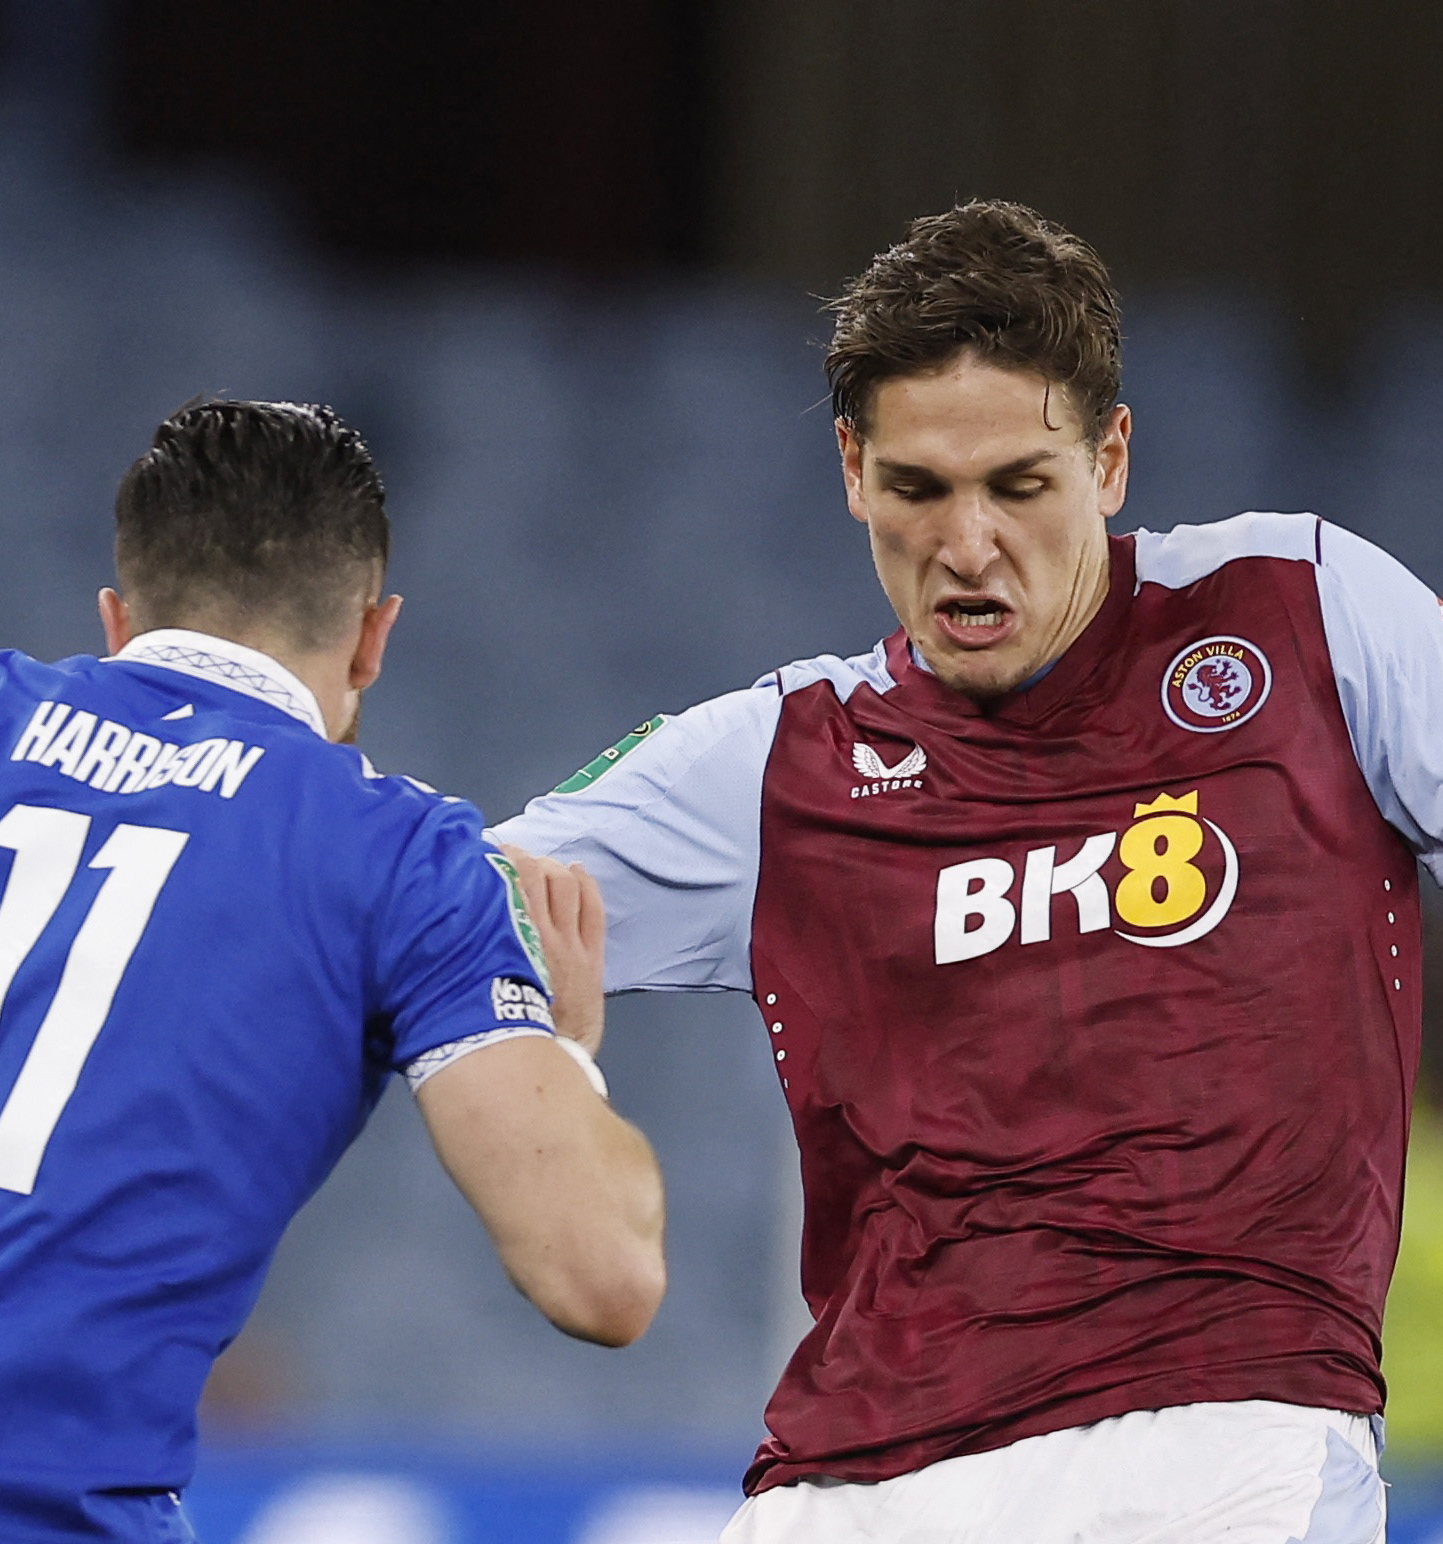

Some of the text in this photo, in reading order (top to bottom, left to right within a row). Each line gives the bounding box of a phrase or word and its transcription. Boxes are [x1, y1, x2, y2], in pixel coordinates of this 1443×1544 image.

[1171, 644, 1245, 688] ASTON VILLA
[850, 779, 923, 799] CASTORE
[934, 813, 1208, 966] BK8
